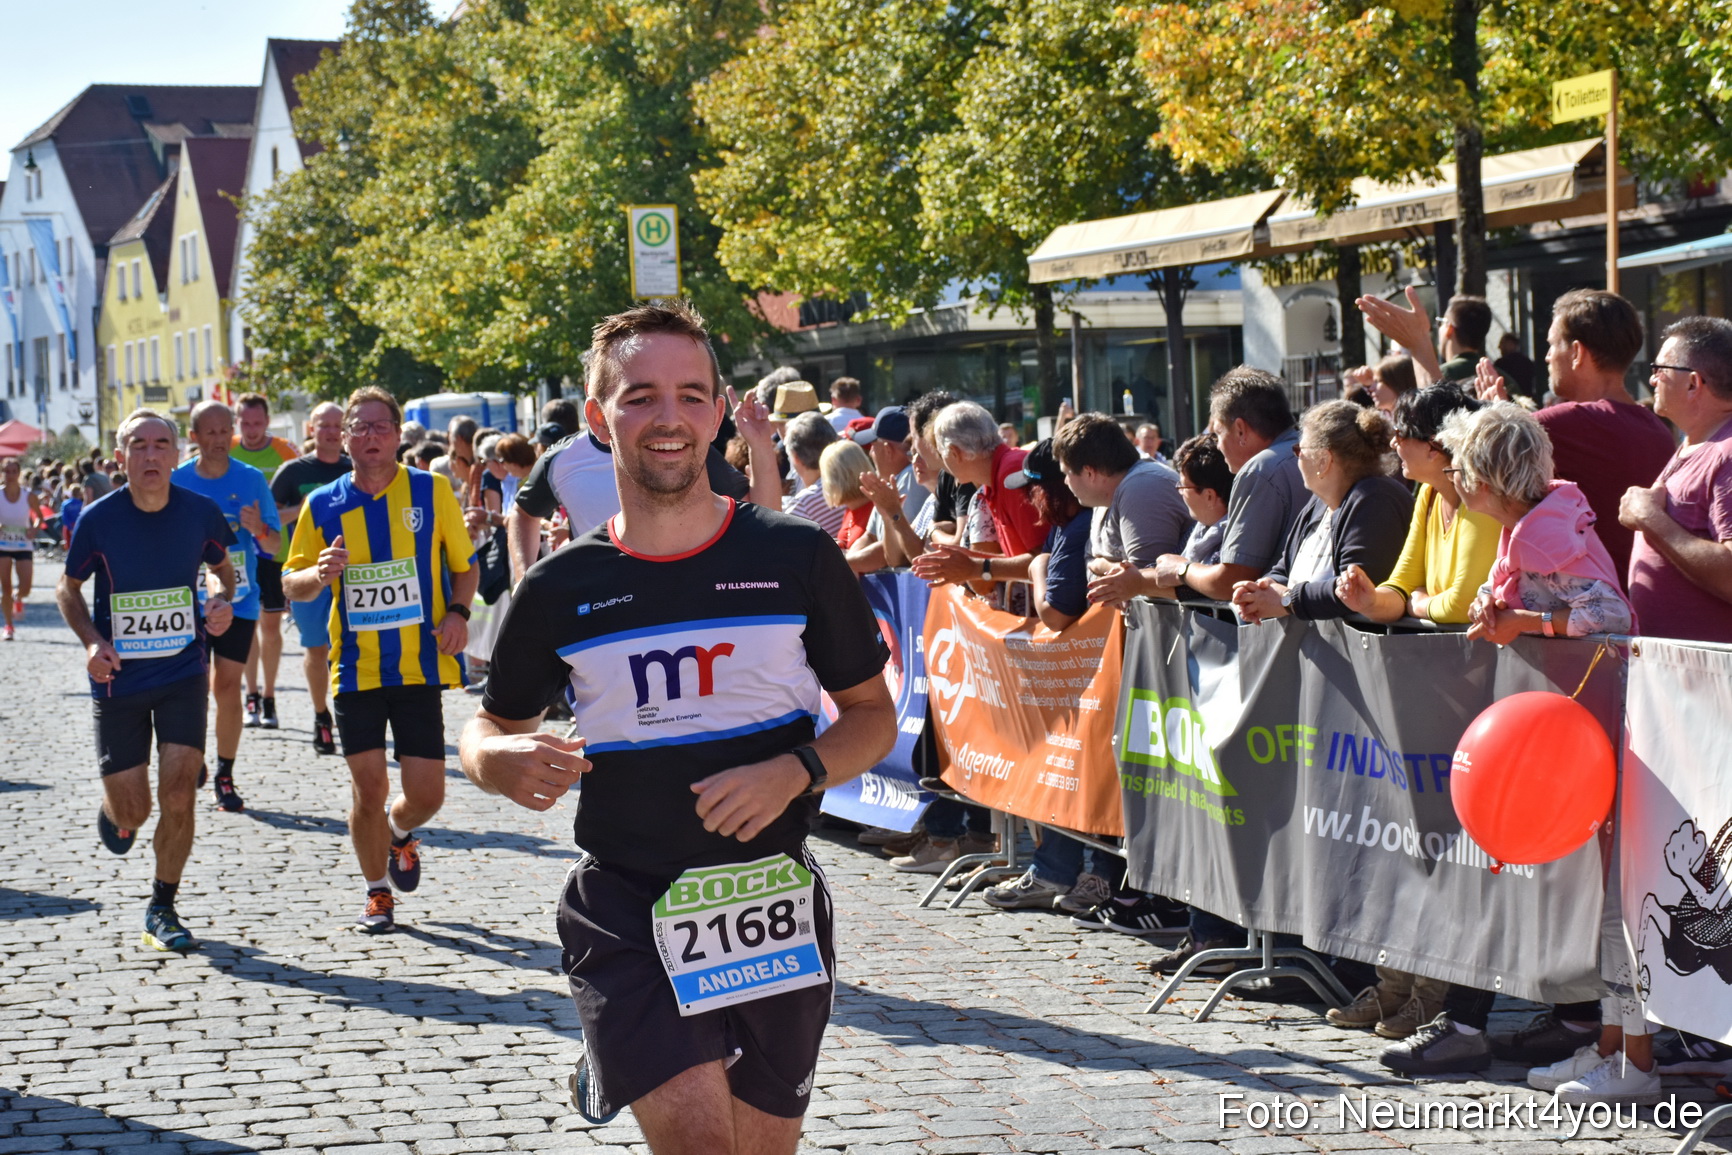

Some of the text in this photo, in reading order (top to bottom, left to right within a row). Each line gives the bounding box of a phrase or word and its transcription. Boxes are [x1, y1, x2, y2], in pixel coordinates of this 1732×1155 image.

[1565, 88, 1608, 108] Toiletten
[645, 220, 662, 239] H
[347, 561, 410, 582] BOCK
[352, 583, 409, 608] 2701
[728, 581, 779, 590] ILLSCHWANG
[117, 590, 185, 610] BOCK
[122, 612, 185, 635] 2440
[362, 612, 401, 623] Wolfgang
[121, 637, 187, 650] WOLFGANG
[1070, 637, 1105, 650] Partner
[1058, 656, 1076, 670] und
[1032, 676, 1066, 692] Projekte
[638, 713, 702, 726] Regenerative Energien
[957, 742, 1015, 781] Agentur
[860, 772, 881, 805] GET
[1119, 767, 1178, 798] inspired
[667, 859, 800, 910] BOCK
[674, 899, 797, 964] 2168
[698, 955, 801, 994] ANDREAS
